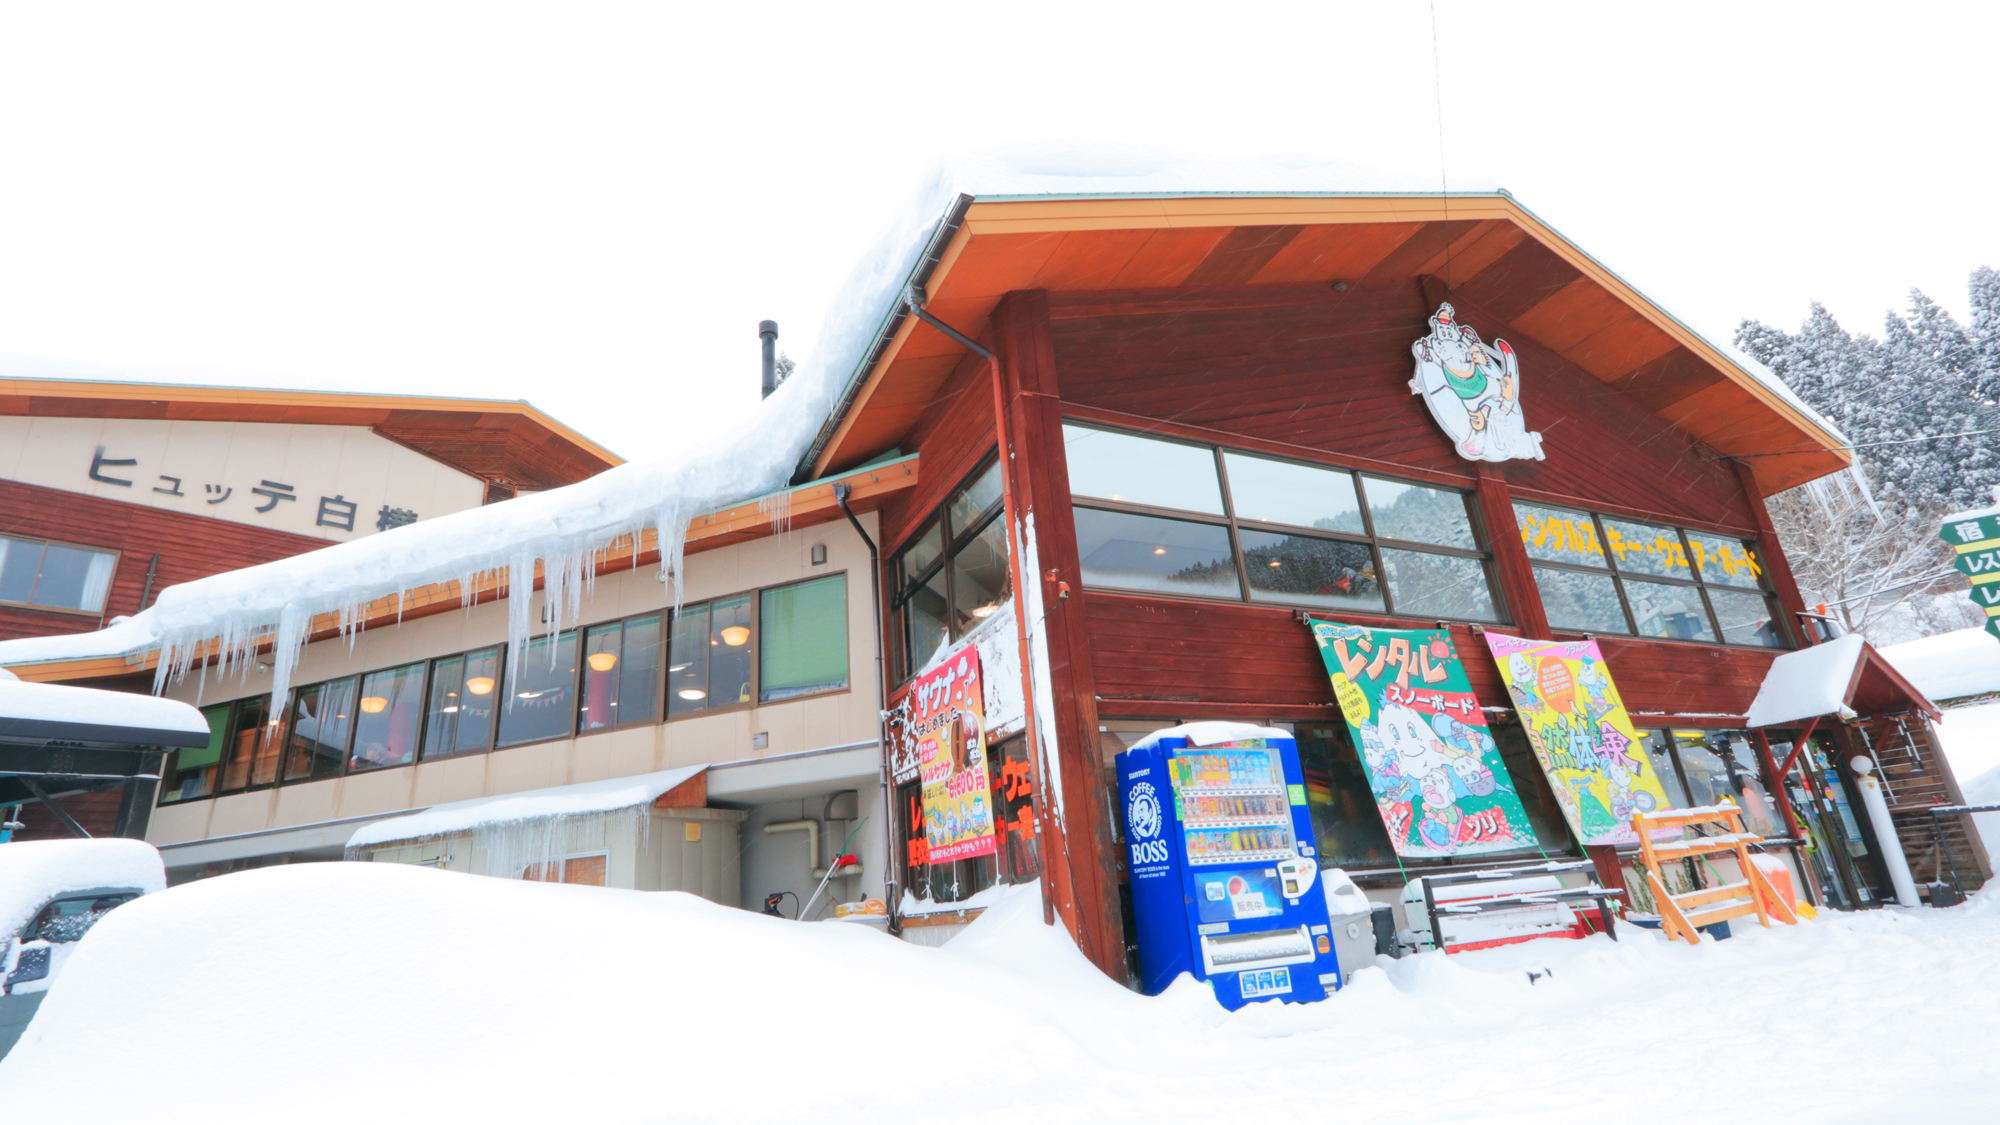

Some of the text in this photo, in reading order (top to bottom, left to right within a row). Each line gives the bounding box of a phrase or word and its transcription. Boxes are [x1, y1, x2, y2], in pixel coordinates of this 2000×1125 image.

[89, 445, 418, 532] ヒュッテ白樺
[1954, 516, 2000, 542] 宿
[1980, 585, 2000, 605] レ
[1333, 637, 1449, 691] レンタル
[918, 665, 957, 719] サウナ
[1389, 685, 1475, 715] スノーボード
[919, 706, 960, 738] はじめました
[1522, 713, 1642, 777] 自然体験
[922, 759, 951, 784] レルサウナ
[1128, 768, 1151, 780] SUNTORY
[1129, 782, 1156, 801] COFFEE
[1466, 815, 1498, 840] ソリ
[1131, 839, 1169, 865] BOSS
[1236, 900, 1263, 912] 販売中
